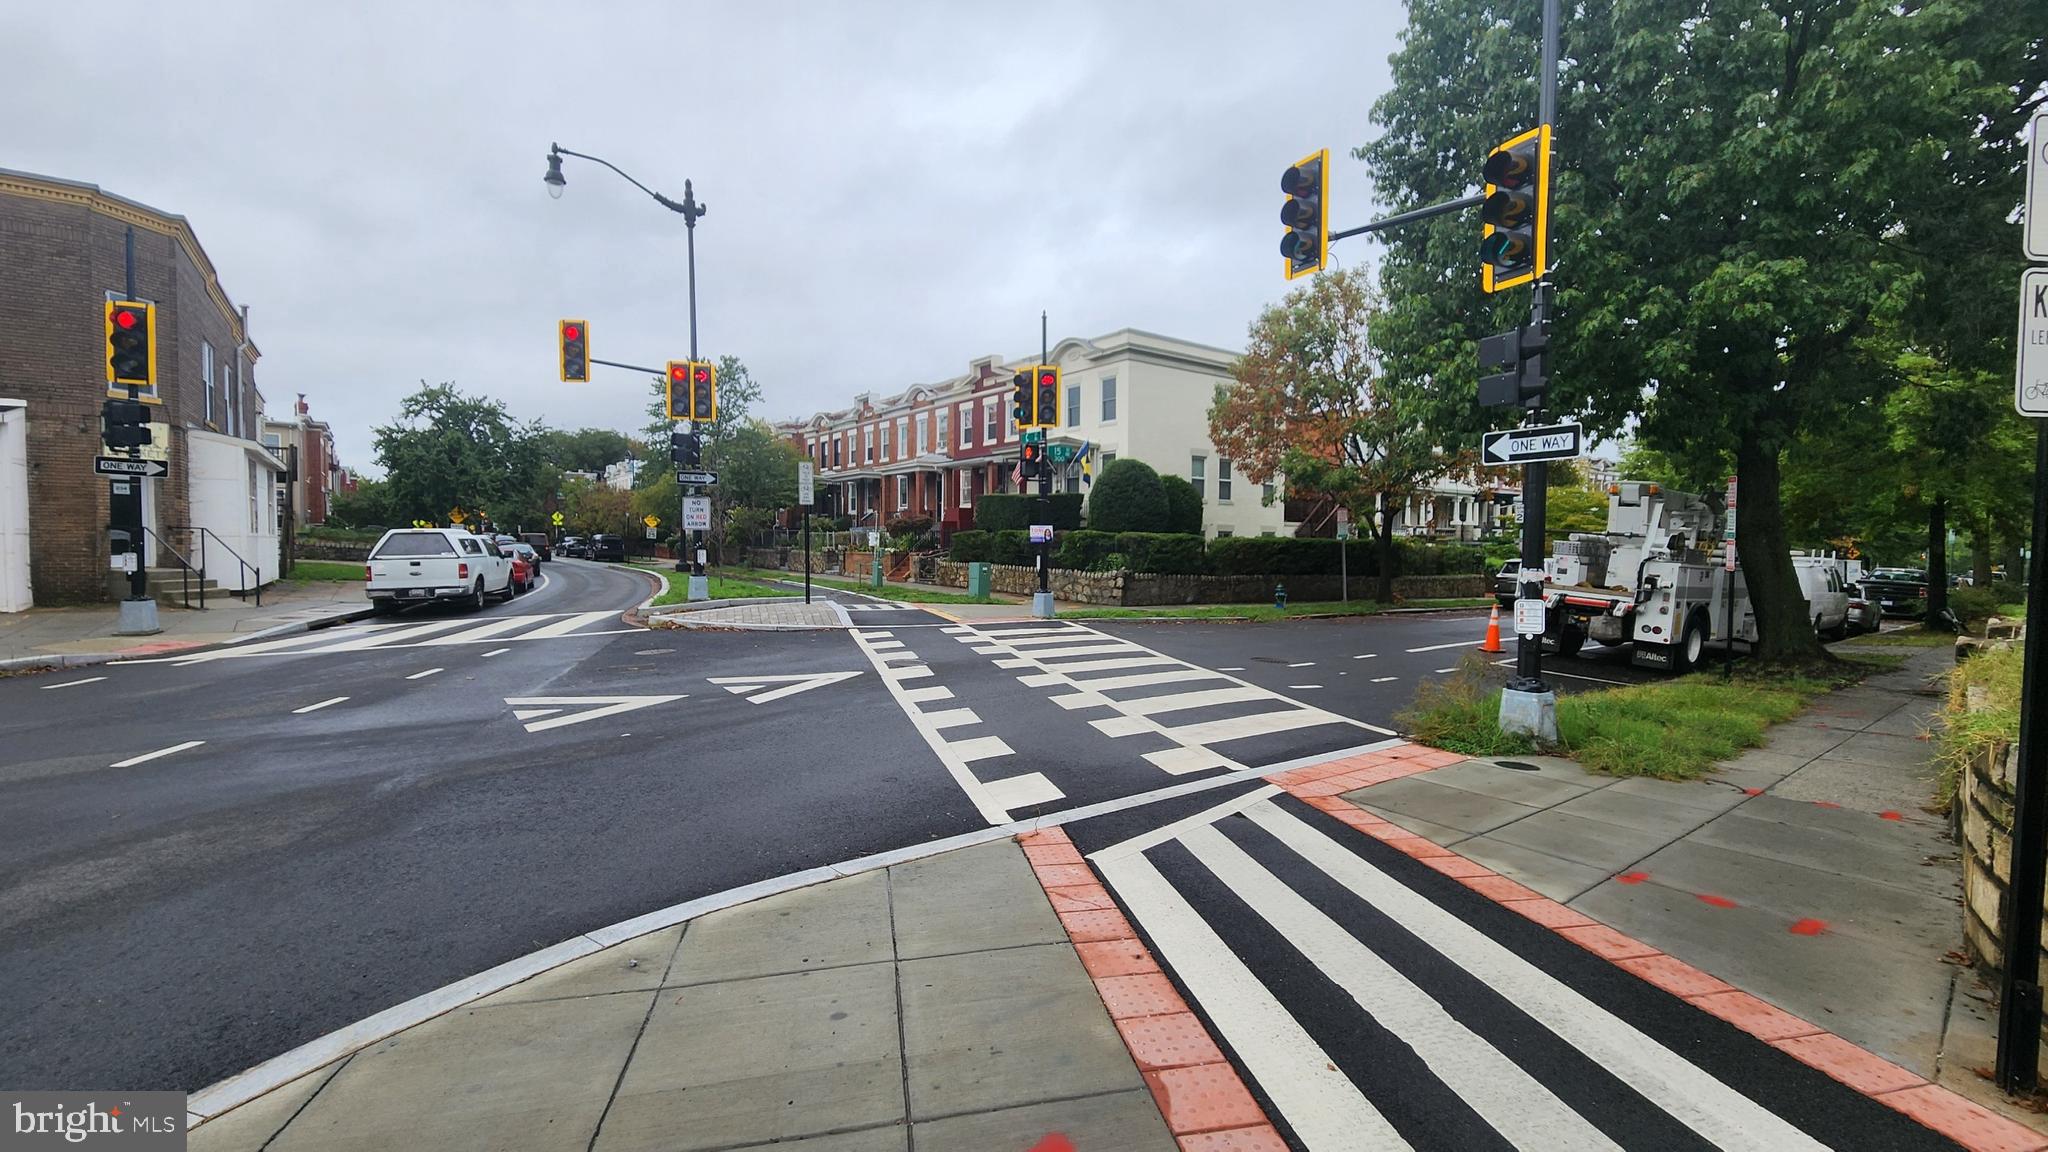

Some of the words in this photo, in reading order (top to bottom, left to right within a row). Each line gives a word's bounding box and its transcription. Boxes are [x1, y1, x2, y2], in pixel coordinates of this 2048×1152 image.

[1511, 438, 1537, 452] ONE
[1542, 435, 1569, 449] WAY
[102, 462, 123, 470] ONE
[126, 463, 146, 471] WAY
[1516, 513, 1523, 521] 2
